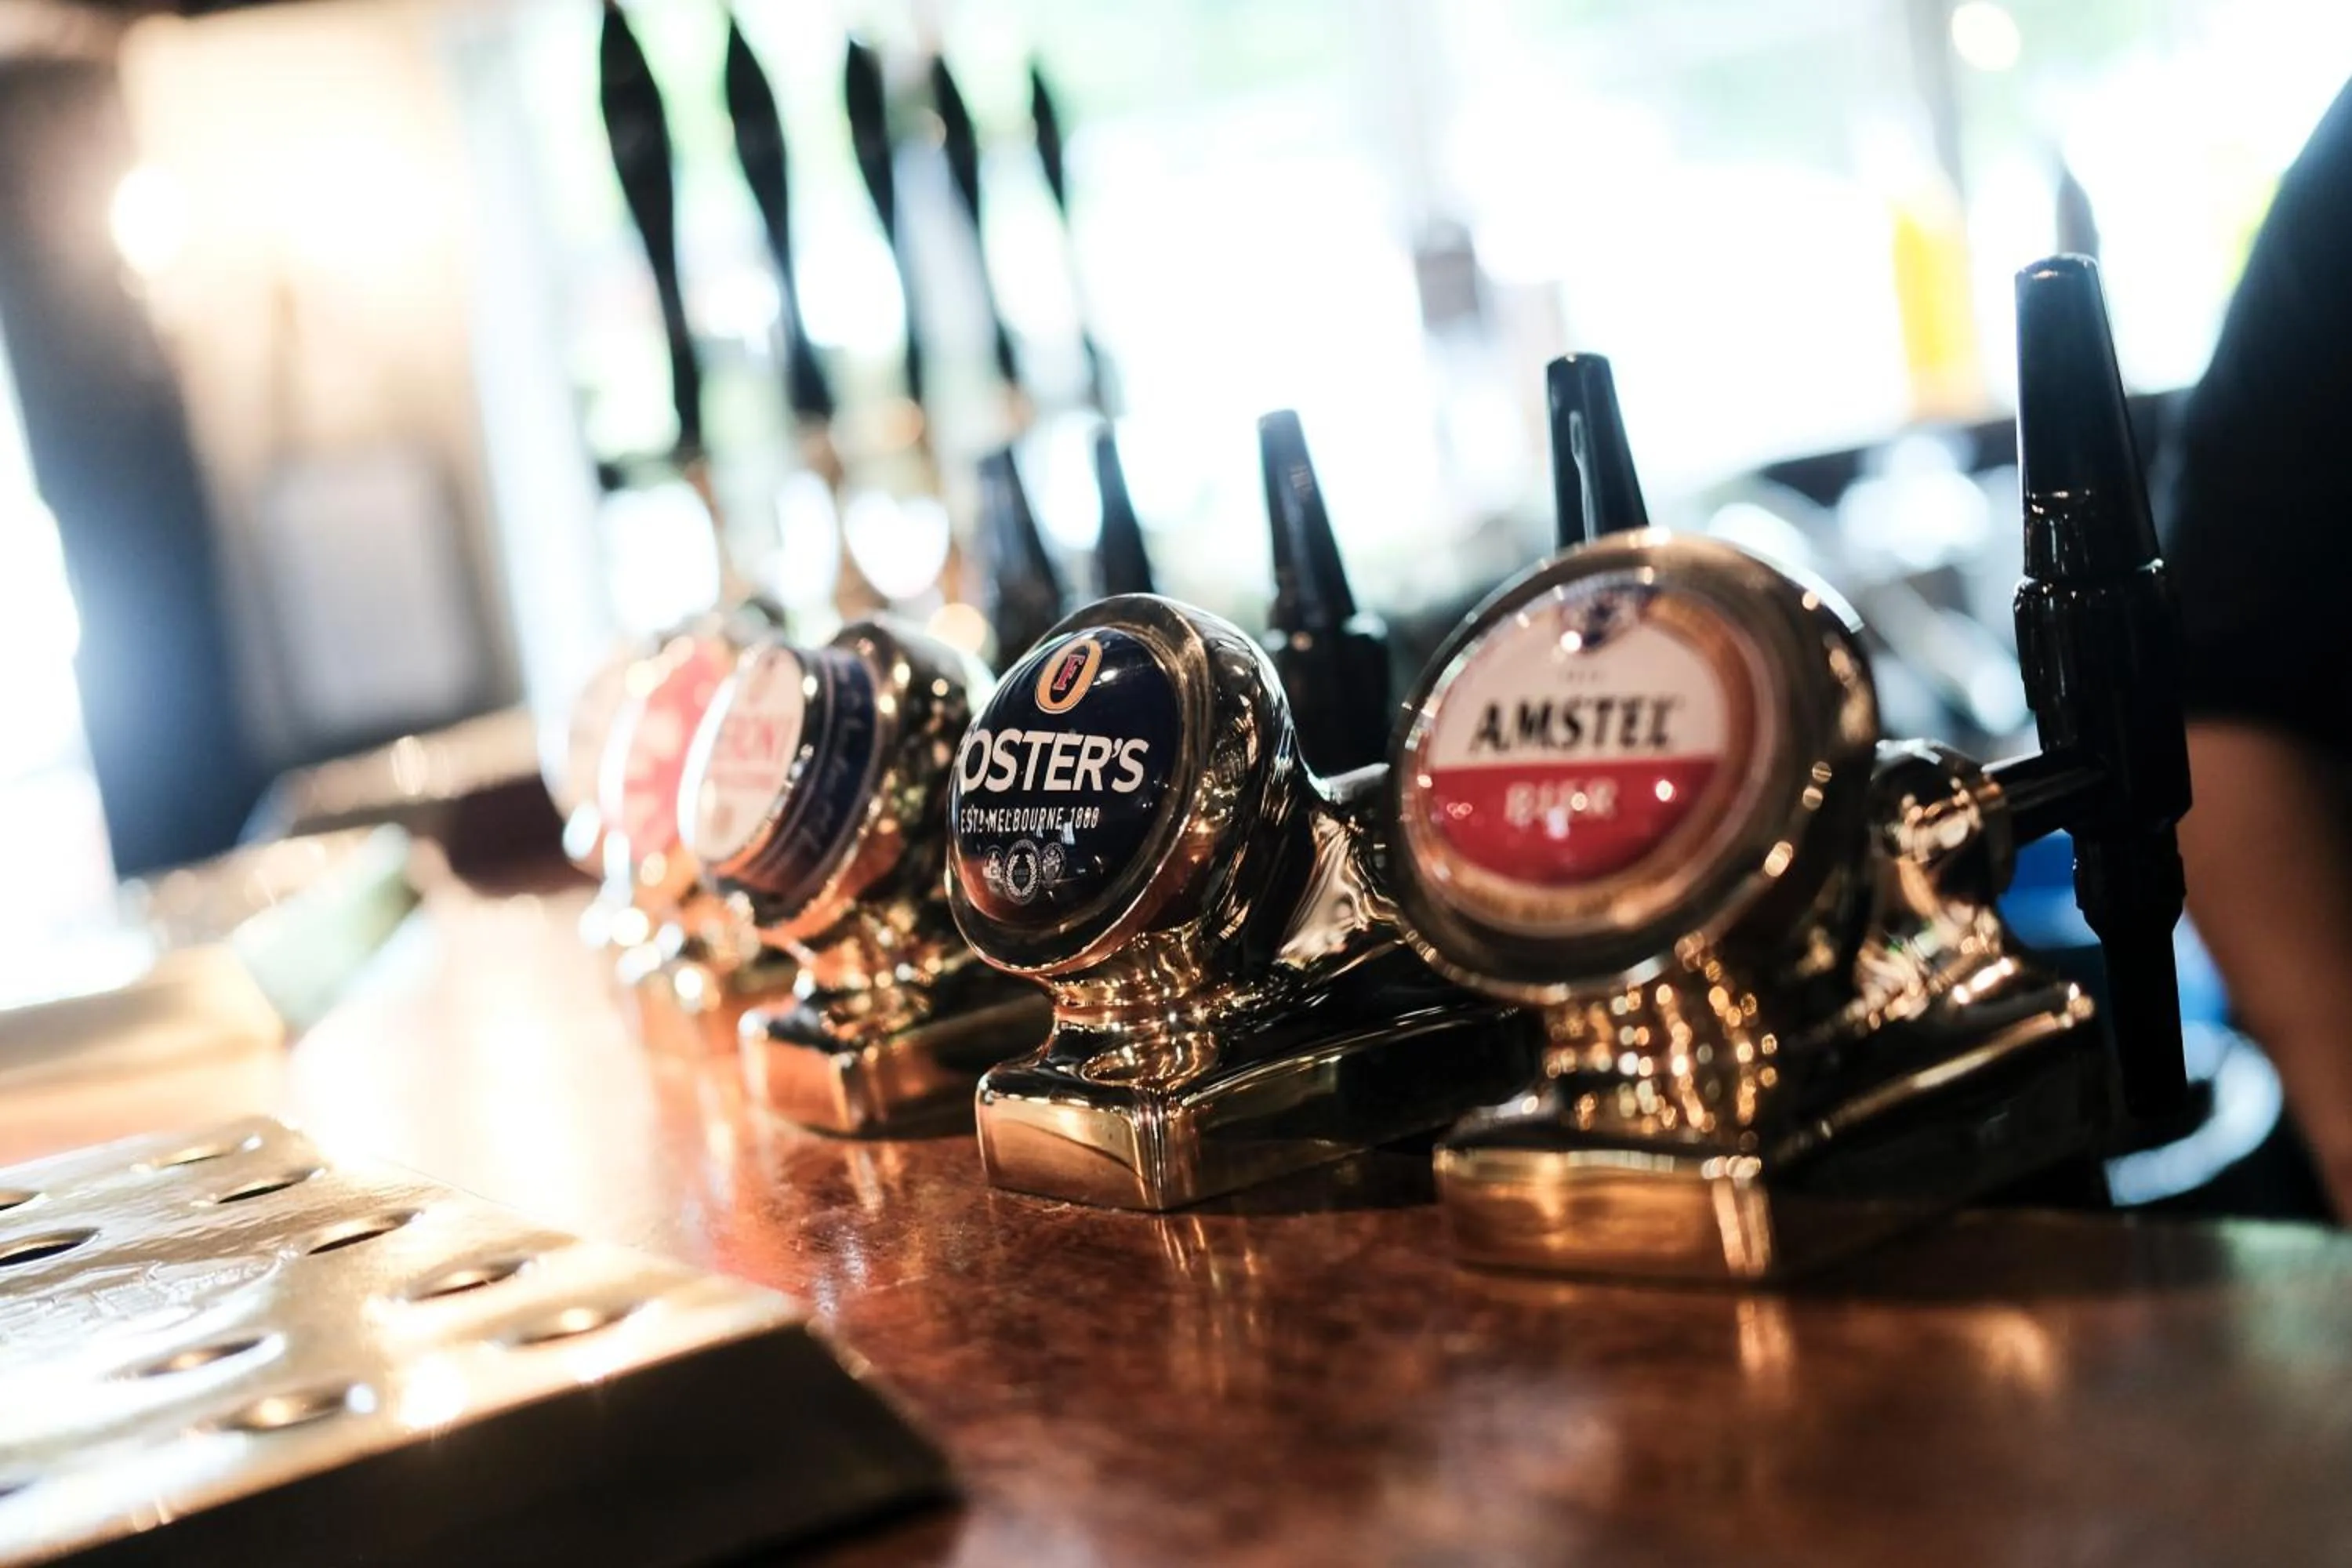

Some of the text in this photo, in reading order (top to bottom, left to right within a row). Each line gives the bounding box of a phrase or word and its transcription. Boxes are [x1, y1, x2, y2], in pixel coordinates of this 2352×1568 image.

[959, 728, 1149, 793] OSTER'S
[987, 808, 1064, 833] MELBOURNE
[1070, 807, 1099, 829] 1888
